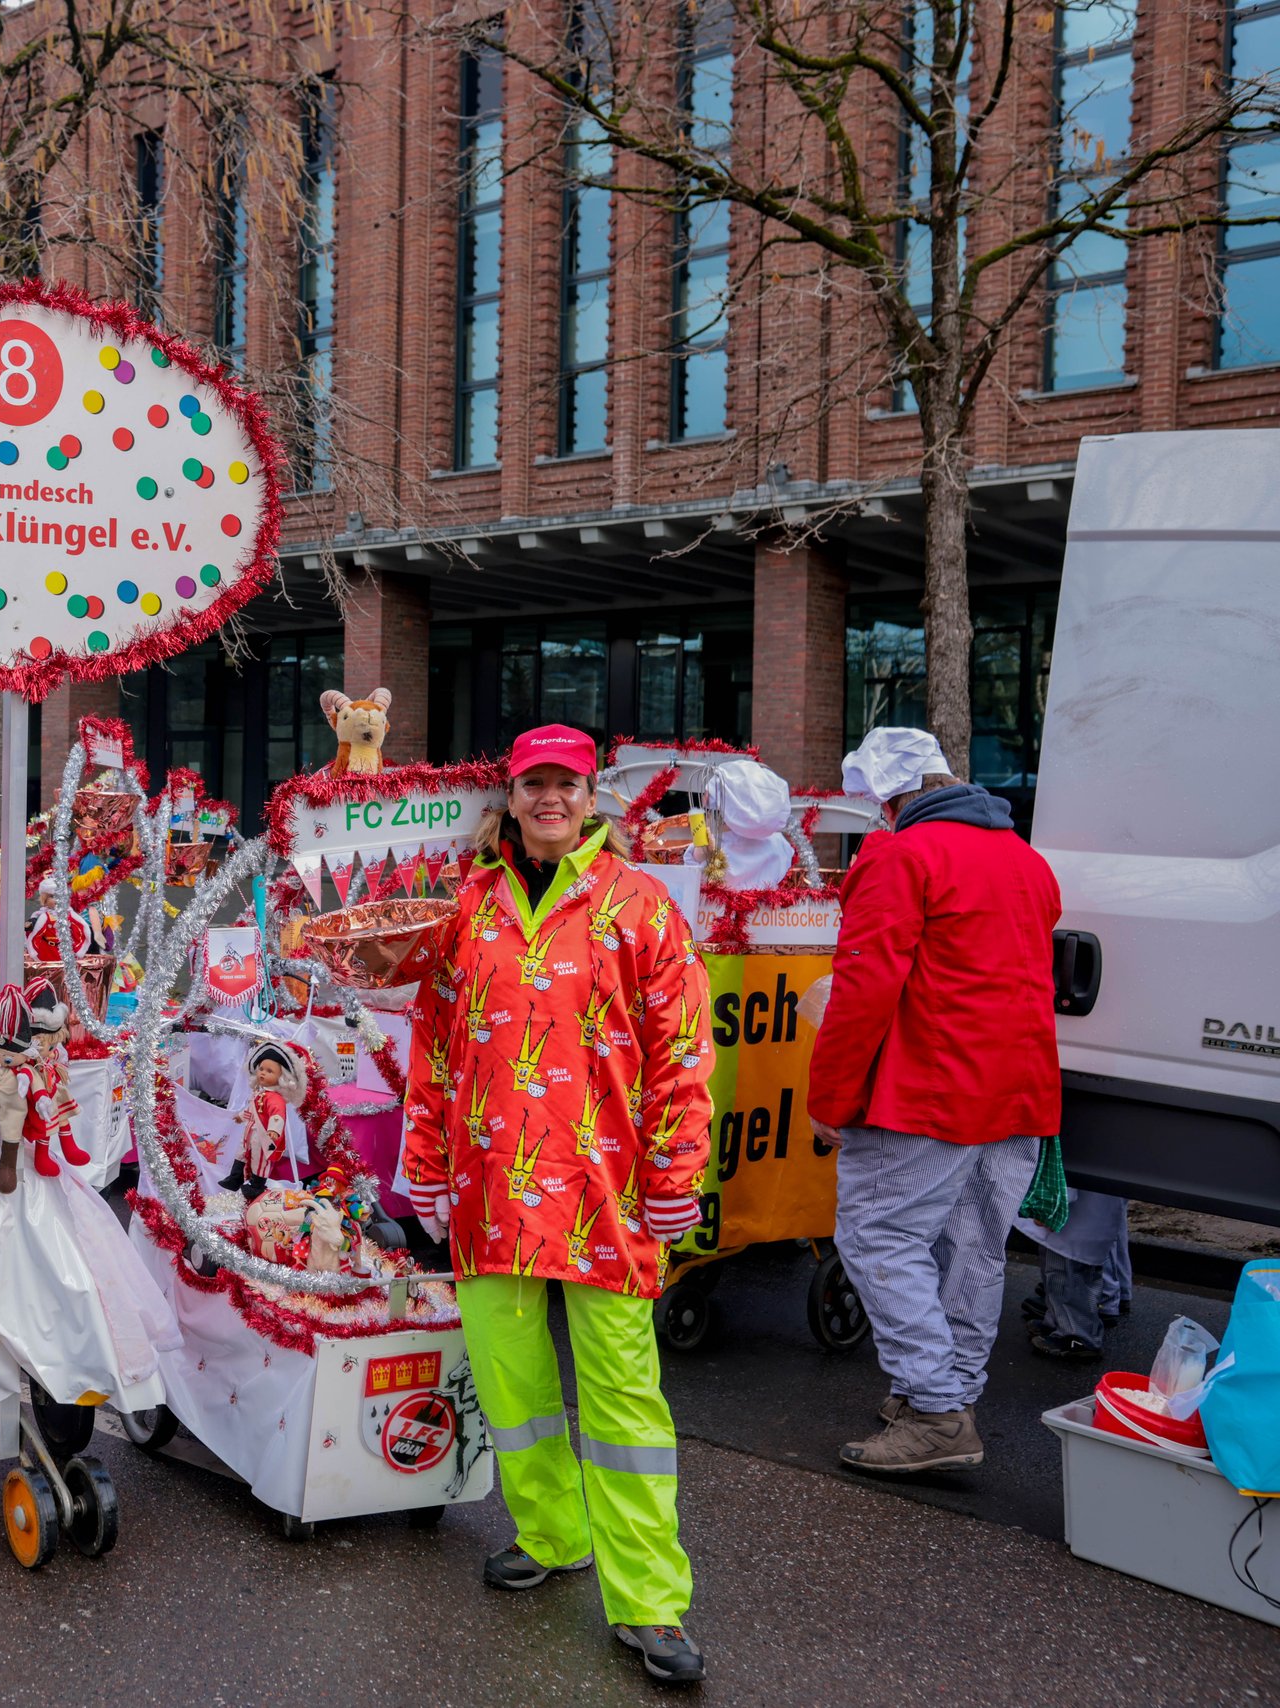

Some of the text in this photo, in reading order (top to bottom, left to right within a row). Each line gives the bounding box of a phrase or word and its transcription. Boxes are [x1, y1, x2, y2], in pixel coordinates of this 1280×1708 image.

[131, 522, 192, 552] e.V.
[346, 798, 462, 832] FC Zupp
[751, 907, 829, 928] Zollstocker
[553, 962, 573, 970] KÖLLE
[558, 967, 578, 976] ALAAF
[713, 973, 798, 1047] sch
[610, 1030, 629, 1039] KÖLLE
[614, 1038, 632, 1046] ALAAF
[547, 1068, 568, 1077] KÖLLE
[552, 1074, 572, 1082] ALAAF
[716, 1088, 794, 1183] gel
[600, 1137, 618, 1145] KÖLLE
[542, 1177, 563, 1185] KÖLLE
[547, 1184, 567, 1192] ALAAF
[595, 1245, 615, 1253] KÖLLE
[599, 1252, 618, 1260] ALAAF
[398, 1422, 444, 1445] 1.FC
[391, 1441, 425, 1457] KÖLN
